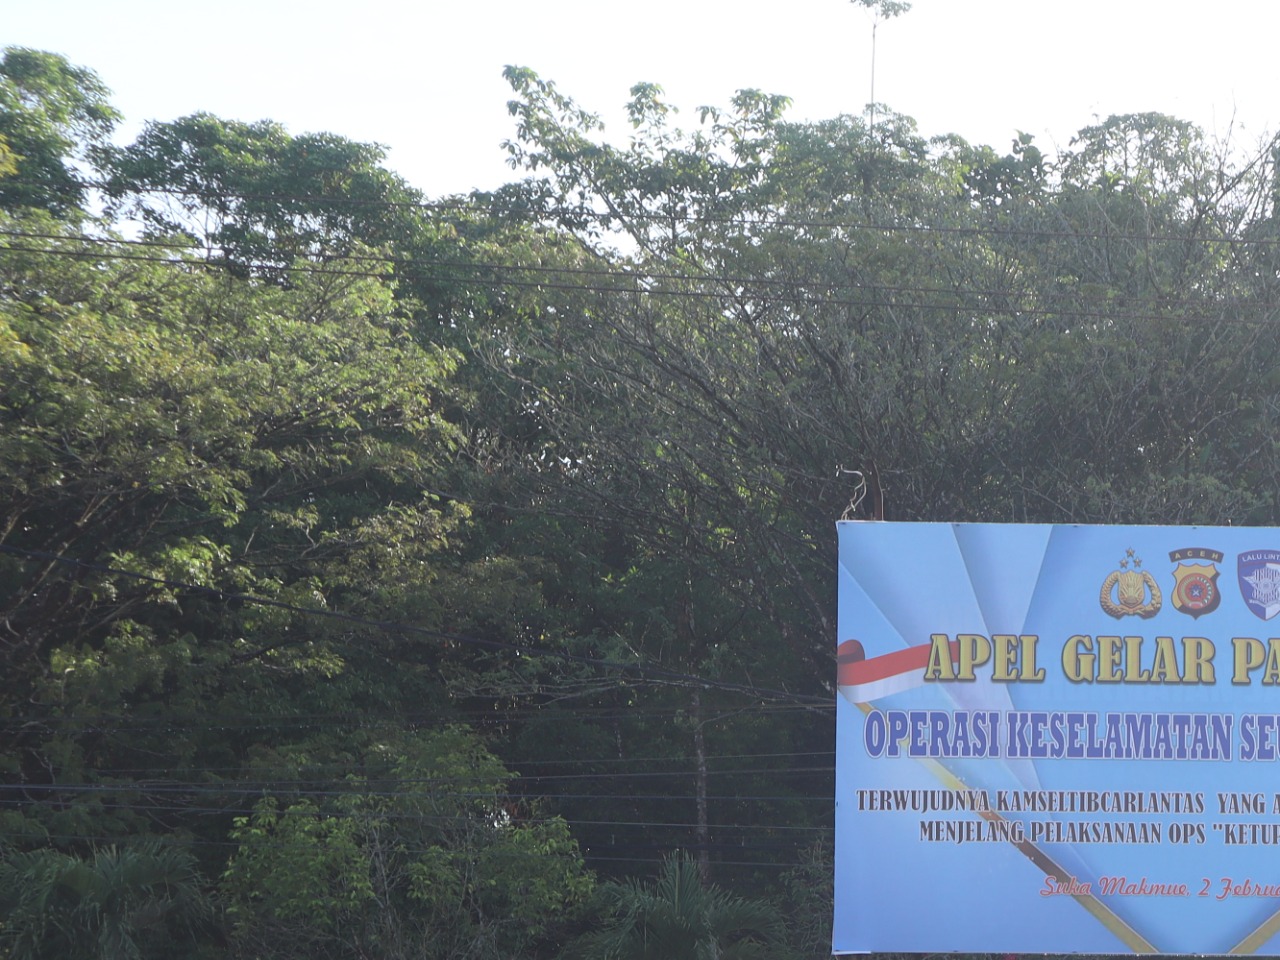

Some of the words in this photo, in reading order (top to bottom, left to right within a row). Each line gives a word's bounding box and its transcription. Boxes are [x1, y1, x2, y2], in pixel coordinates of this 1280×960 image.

[1175, 550, 1218, 560] ACEH
[1242, 553, 1262, 562] LALU
[924, 633, 1047, 683] APEL
[1062, 634, 1217, 686] GELAR
[864, 709, 1000, 758] OPERASI
[1006, 711, 1233, 761] KESELAMATAN
[856, 789, 990, 814] TERWUJUDNYA
[998, 789, 1205, 815] KAMSELTIBCARLANTAS
[1217, 792, 1266, 816] YANG
[919, 820, 1025, 845] MENJELANG
[1031, 821, 1162, 844] PELAKSANAAN
[1168, 822, 1206, 845] OPS
[1039, 875, 1092, 897] Suka
[1198, 878, 1211, 897] 2
